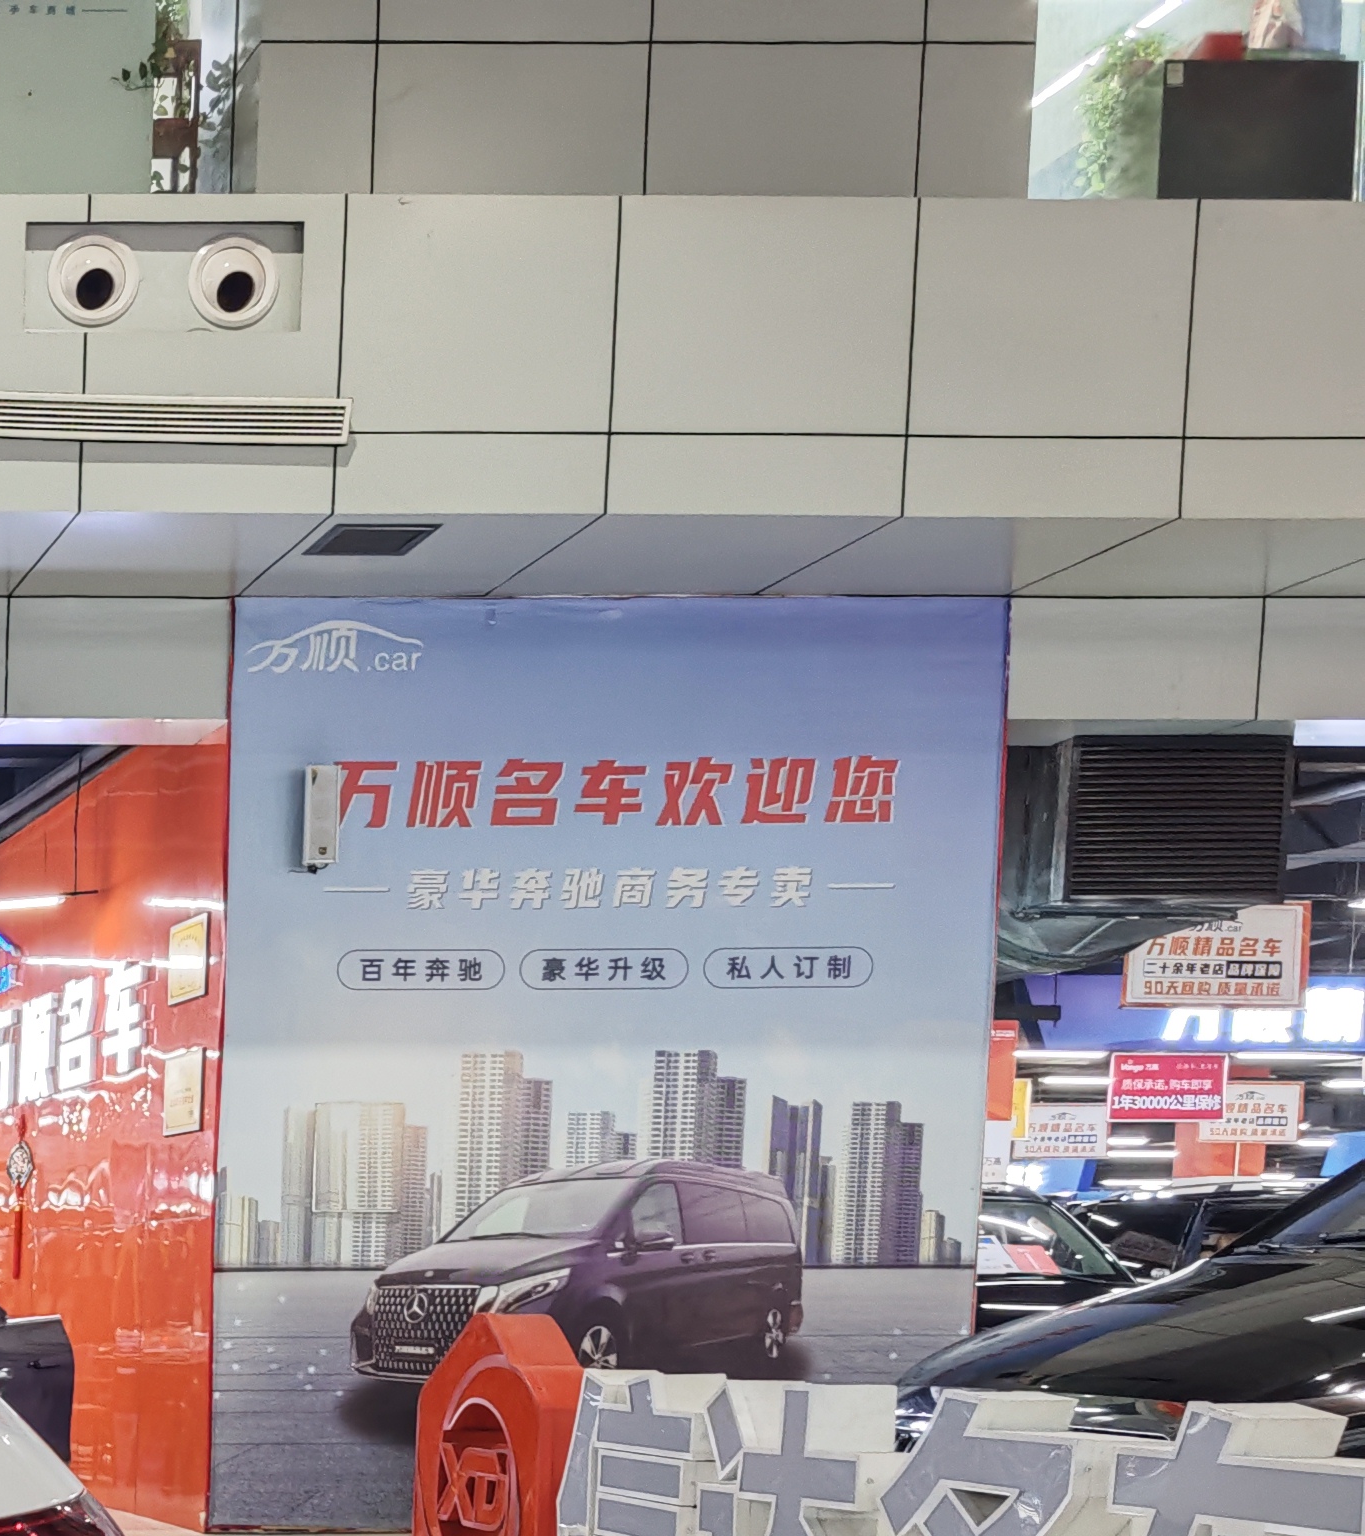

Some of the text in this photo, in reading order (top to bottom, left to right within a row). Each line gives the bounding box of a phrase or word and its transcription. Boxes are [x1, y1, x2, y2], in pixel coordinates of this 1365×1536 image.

[333, 753, 903, 830] 万顺名车欢迎您
[405, 865, 815, 911] 豪华奔驰商务专卖
[1145, 935, 1284, 958] 万顺精品名车
[359, 956, 484, 983] 百年奔驰
[540, 955, 668, 983] 豪华升级
[726, 954, 854, 982] 私人订制
